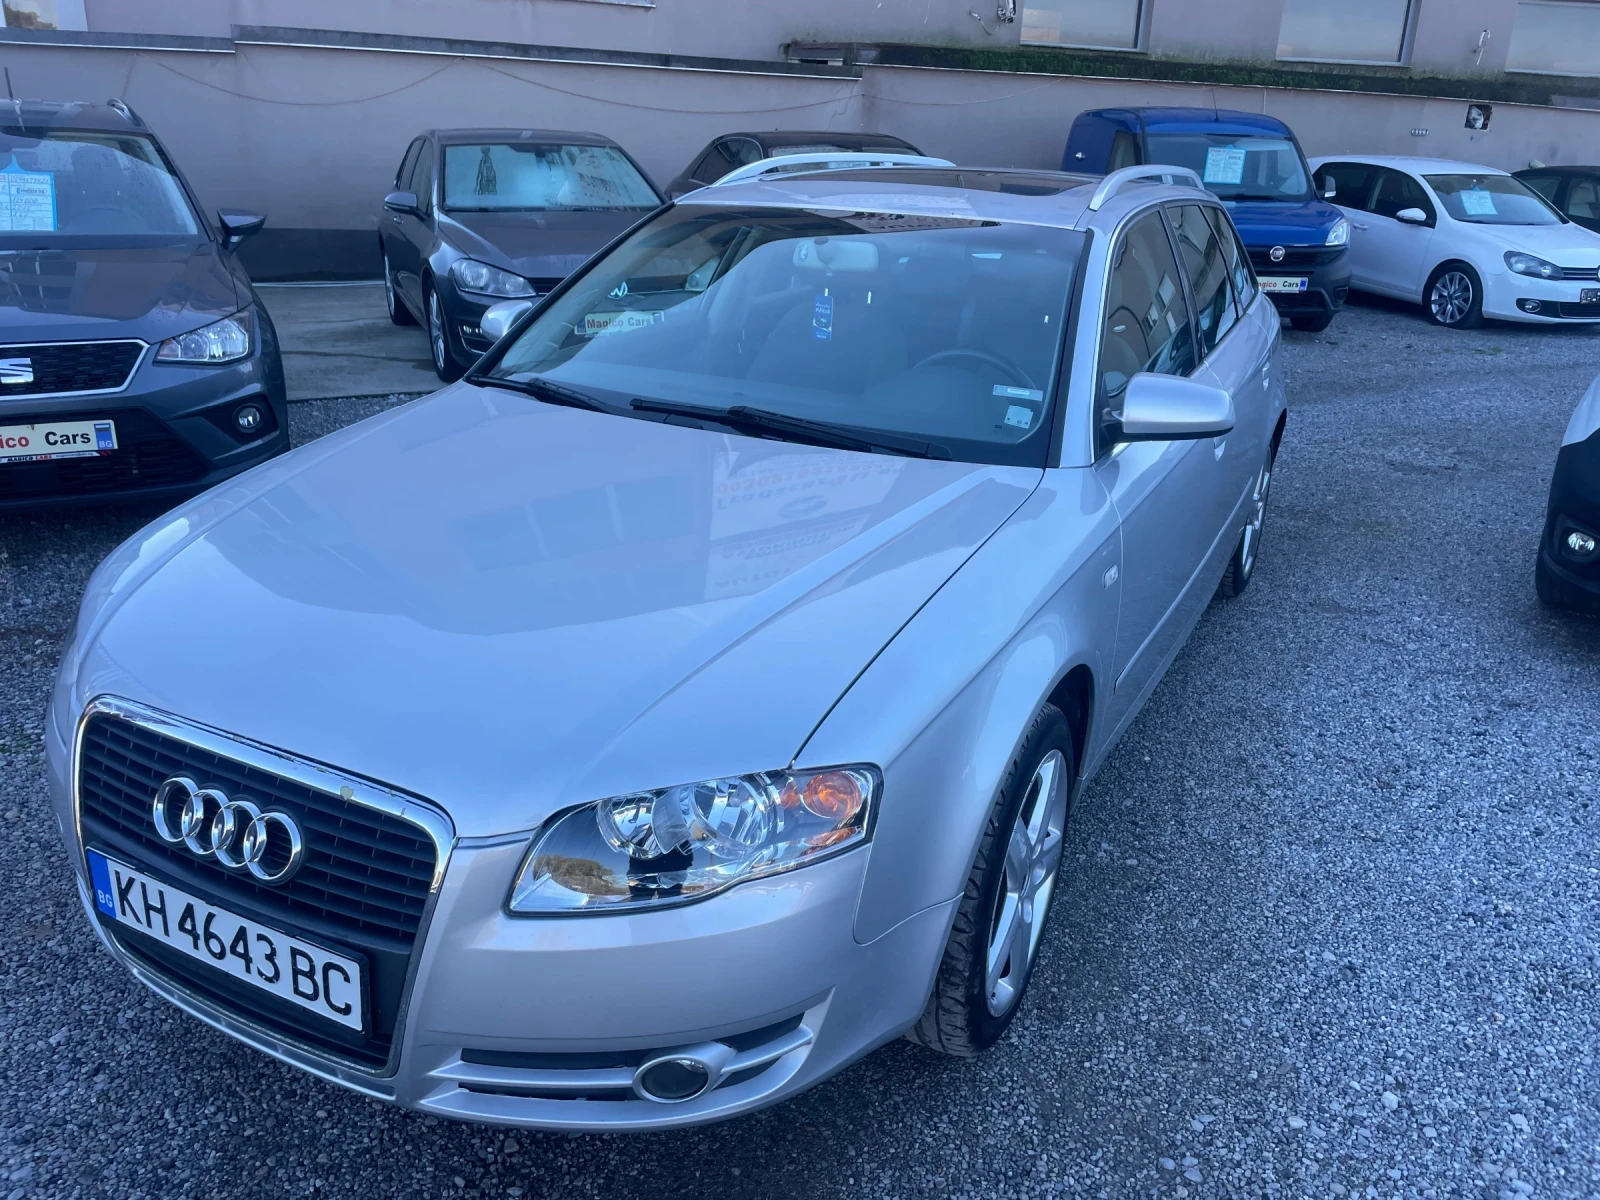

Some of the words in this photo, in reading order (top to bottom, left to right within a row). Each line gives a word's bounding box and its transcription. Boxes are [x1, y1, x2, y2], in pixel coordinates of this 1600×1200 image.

[1259, 281, 1277, 289] gico
[1282, 280, 1299, 288] Cars
[586, 317, 624, 330] Magico
[627, 316, 652, 327] Cars
[0, 434, 30, 449] ico
[44, 431, 91, 446] Cars
[99, 440, 113, 448] BG
[97, 888, 113, 909] BG
